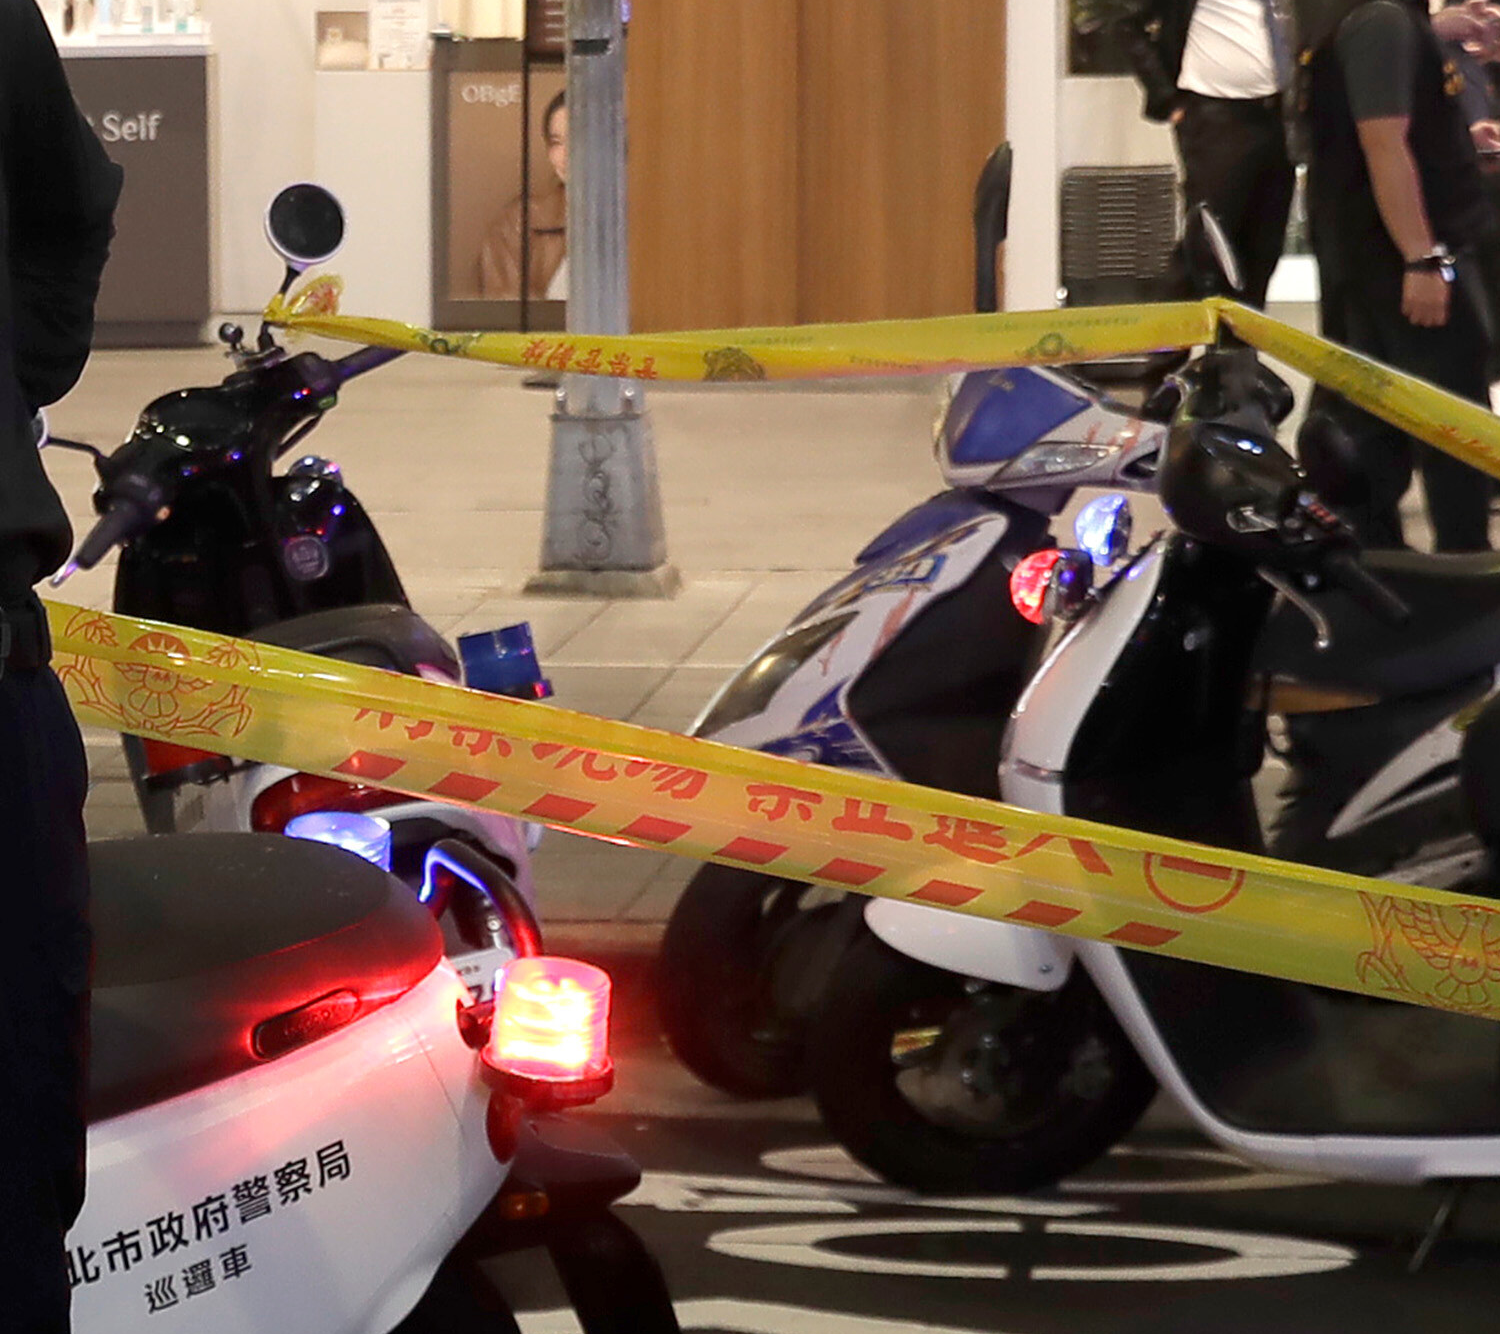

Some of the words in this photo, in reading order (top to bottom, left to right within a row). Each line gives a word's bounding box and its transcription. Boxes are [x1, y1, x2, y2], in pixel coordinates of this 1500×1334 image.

[101, 111, 161, 144] Self
[143, 1242, 253, 1315] 巡邏車
